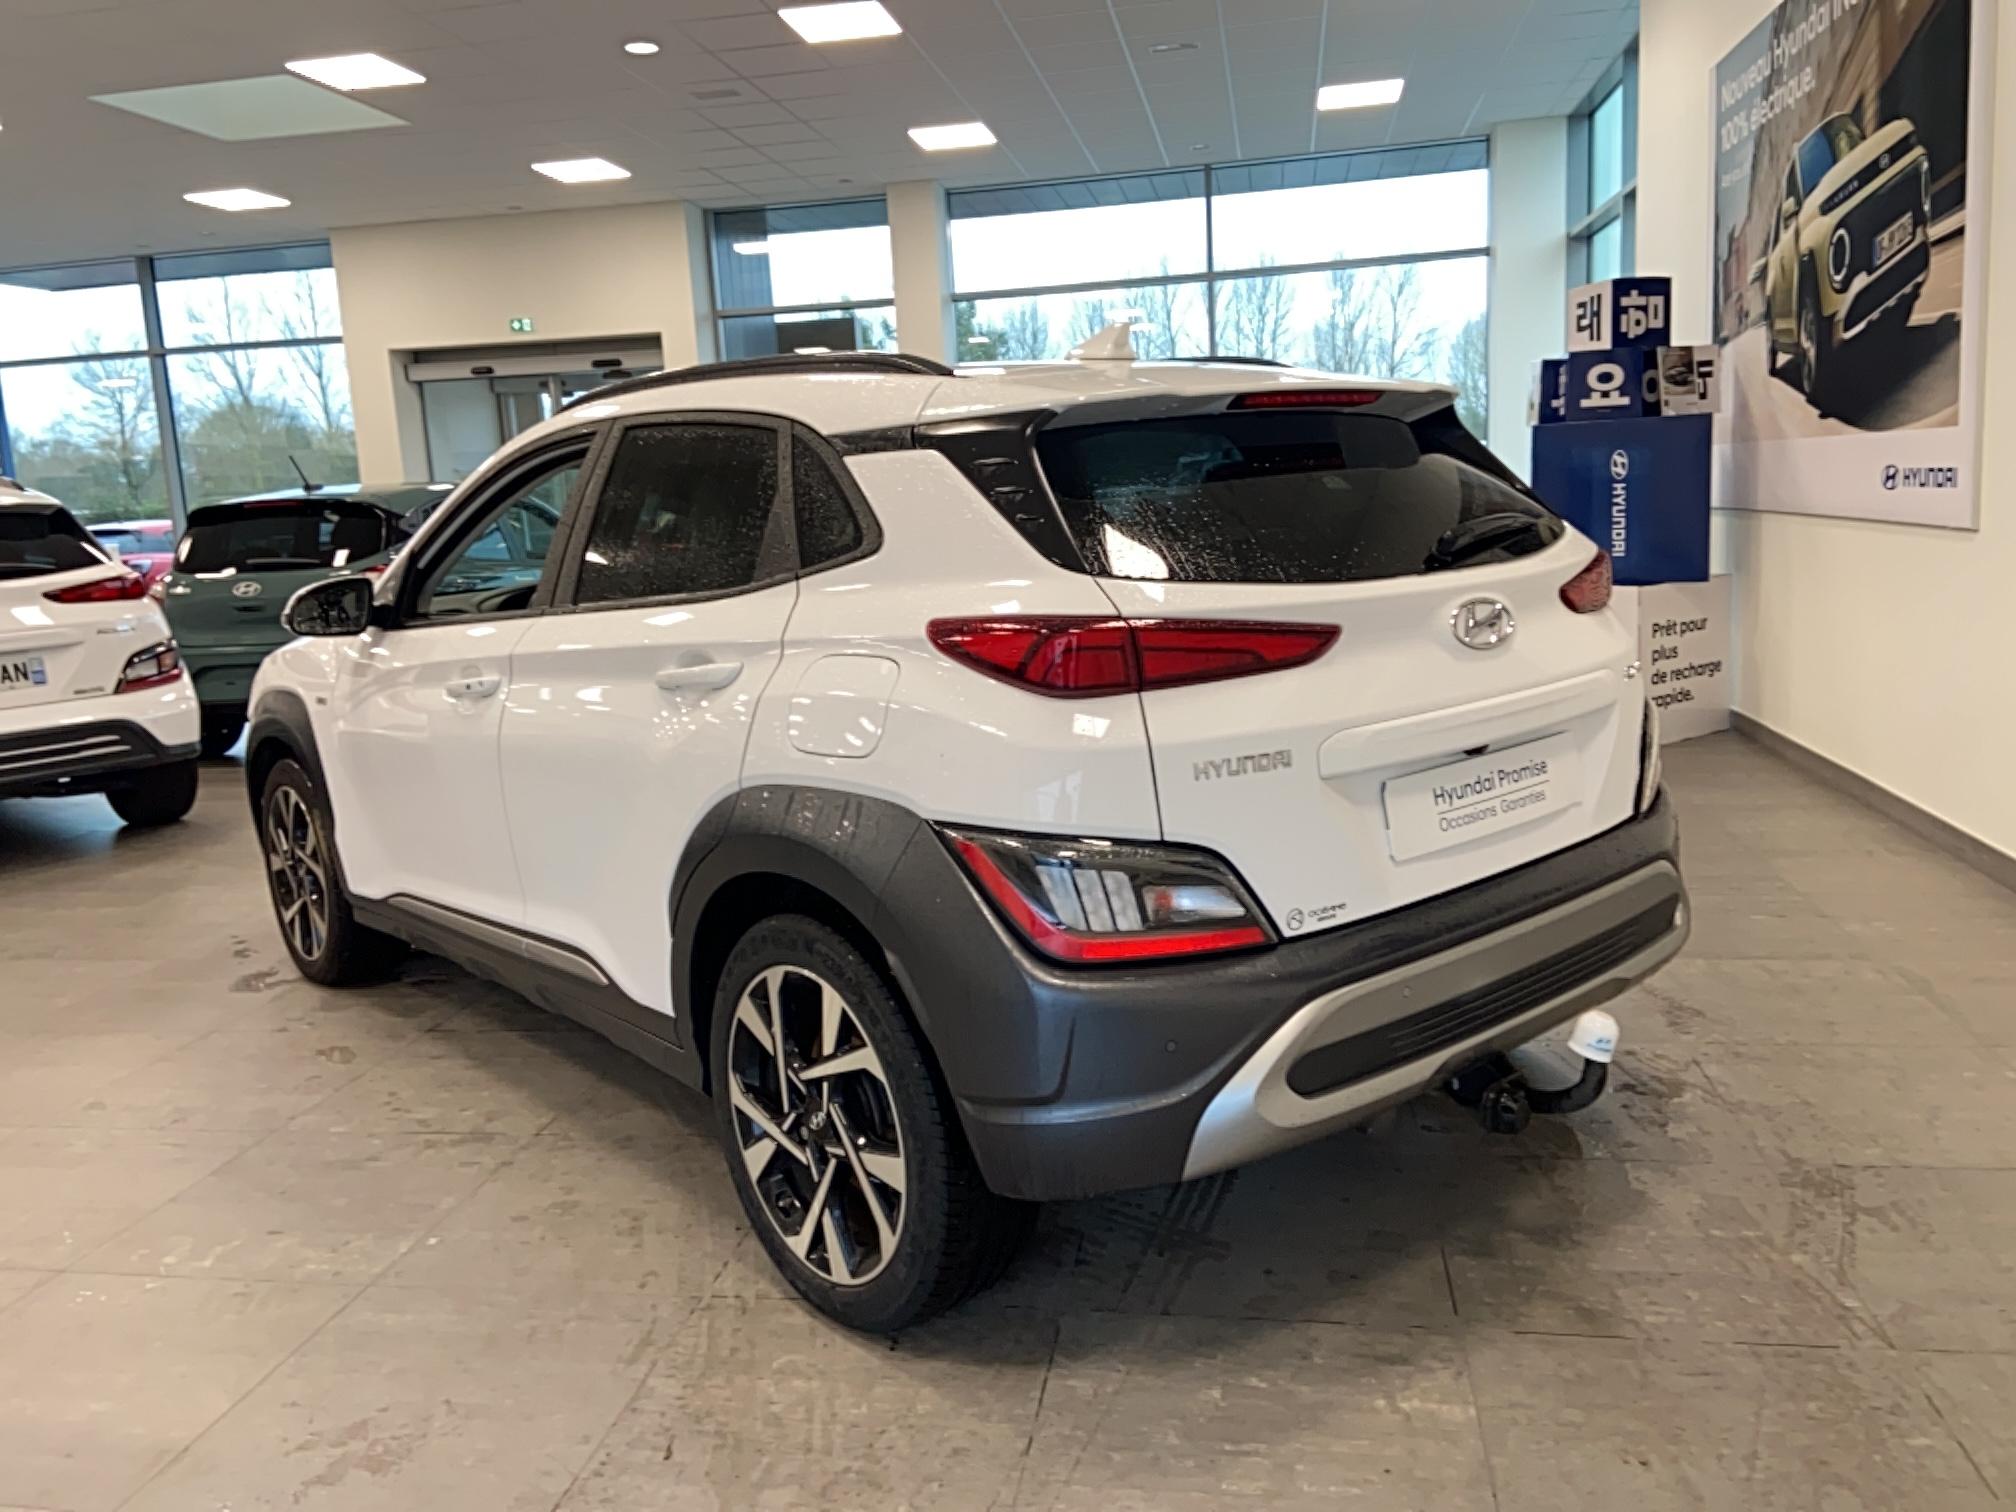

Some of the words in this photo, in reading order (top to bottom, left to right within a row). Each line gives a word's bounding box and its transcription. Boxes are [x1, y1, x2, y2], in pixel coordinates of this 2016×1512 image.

[1721, 51, 1771, 112] Nouveau
[1721, 111, 1748, 153] 100%
[1576, 293, 1602, 341] 래
[1902, 467, 1957, 488] HYUNDAI
[1611, 483, 1627, 557] HYUNDAI
[1652, 619, 1678, 638] Prêt
[1680, 617, 1708, 637] pour
[1651, 670, 1668, 685] de
[1670, 660, 1722, 682] recharge
[1652, 645, 1678, 665] plus
[1192, 749, 1292, 781] HYUNDAI
[1432, 771, 1497, 807] Hyundai
[1497, 759, 1548, 788] Promise
[1439, 806, 1498, 832] Occasions
[1500, 790, 1547, 814] Garanties
